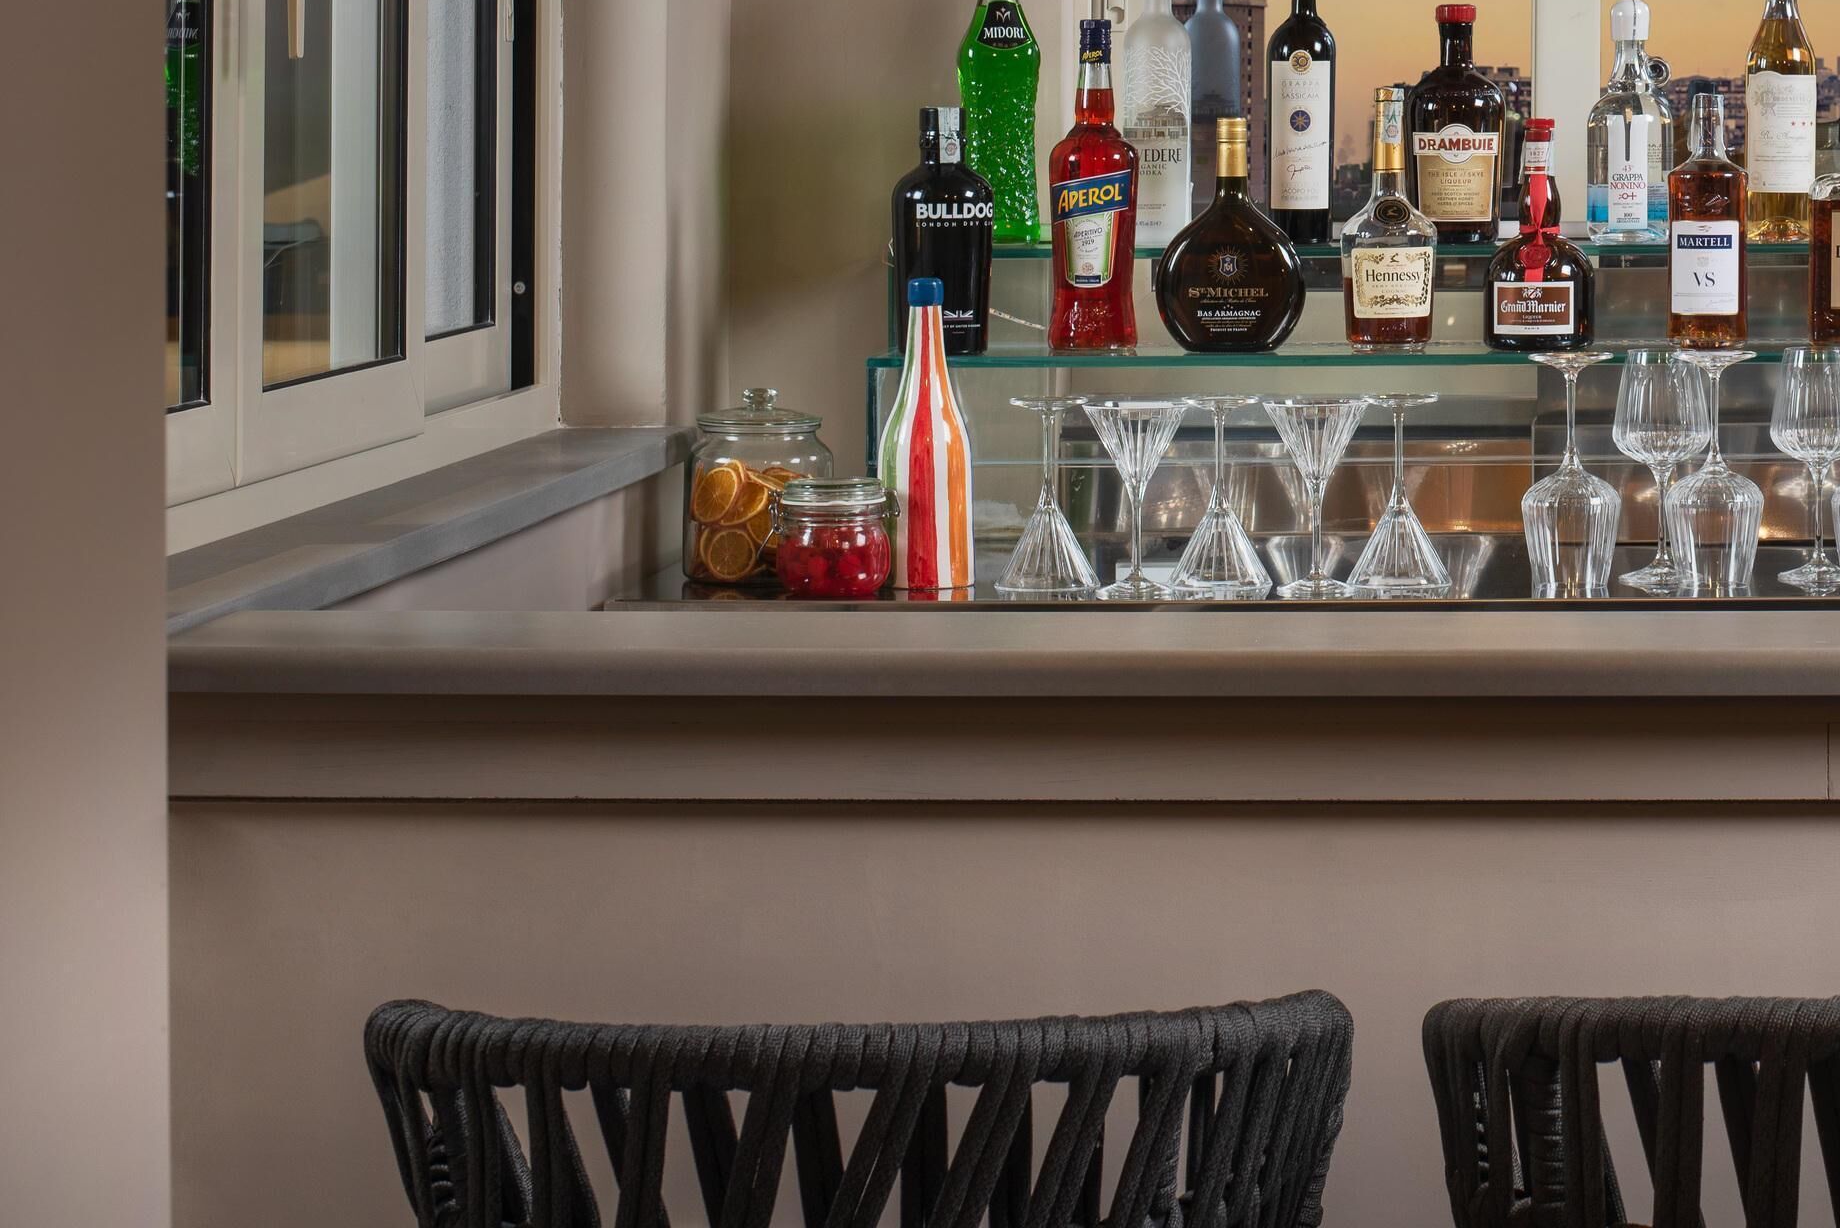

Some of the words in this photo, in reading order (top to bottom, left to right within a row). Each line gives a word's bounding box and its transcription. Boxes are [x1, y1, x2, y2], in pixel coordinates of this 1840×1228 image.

[983, 26, 1025, 40] MIDORI
[1418, 138, 1494, 151] DRAMBUIE
[1612, 173, 1644, 181] GRAPPA
[1610, 182, 1646, 190] NONINO
[1058, 183, 1122, 214] APEROL
[916, 202, 993, 219] BULLDOG
[1680, 237, 1729, 247] MARTELL
[1366, 269, 1420, 283] Hennessy
[1693, 272, 1715, 287] VS
[1207, 286, 1269, 298] MICHEL
[1214, 309, 1261, 317] ARMAGNAC
